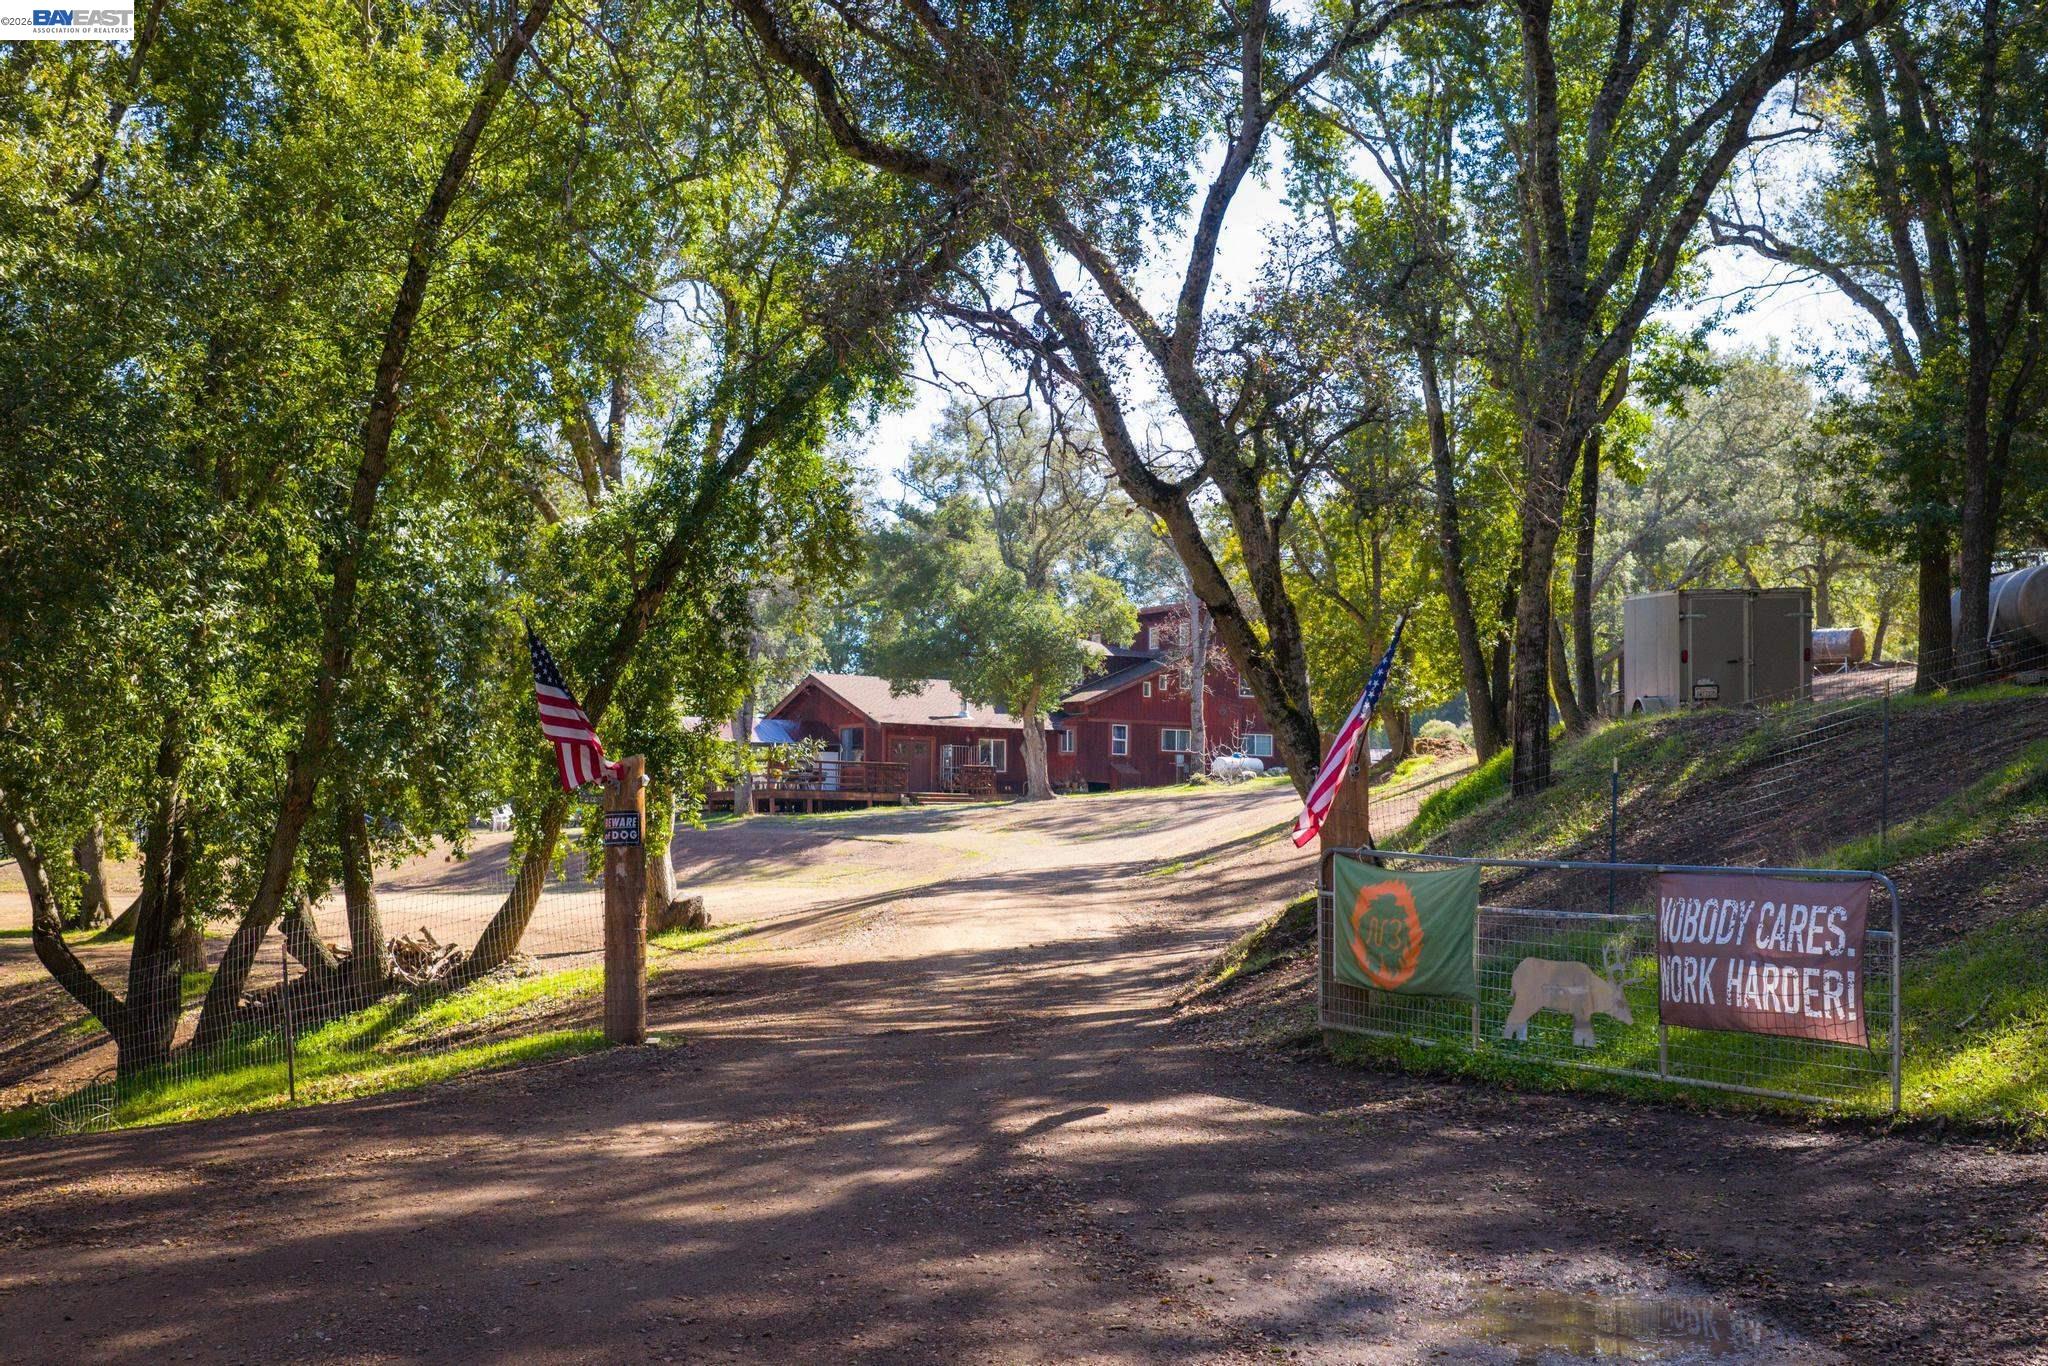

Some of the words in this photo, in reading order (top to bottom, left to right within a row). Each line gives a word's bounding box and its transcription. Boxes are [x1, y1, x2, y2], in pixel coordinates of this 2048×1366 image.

[612, 831, 638, 840] DOG
[1660, 897, 1755, 945] NOBODY
[1756, 902, 1856, 957] CARES.
[1660, 955, 1716, 1005] WORK
[1726, 958, 1857, 1021] HARDER!
